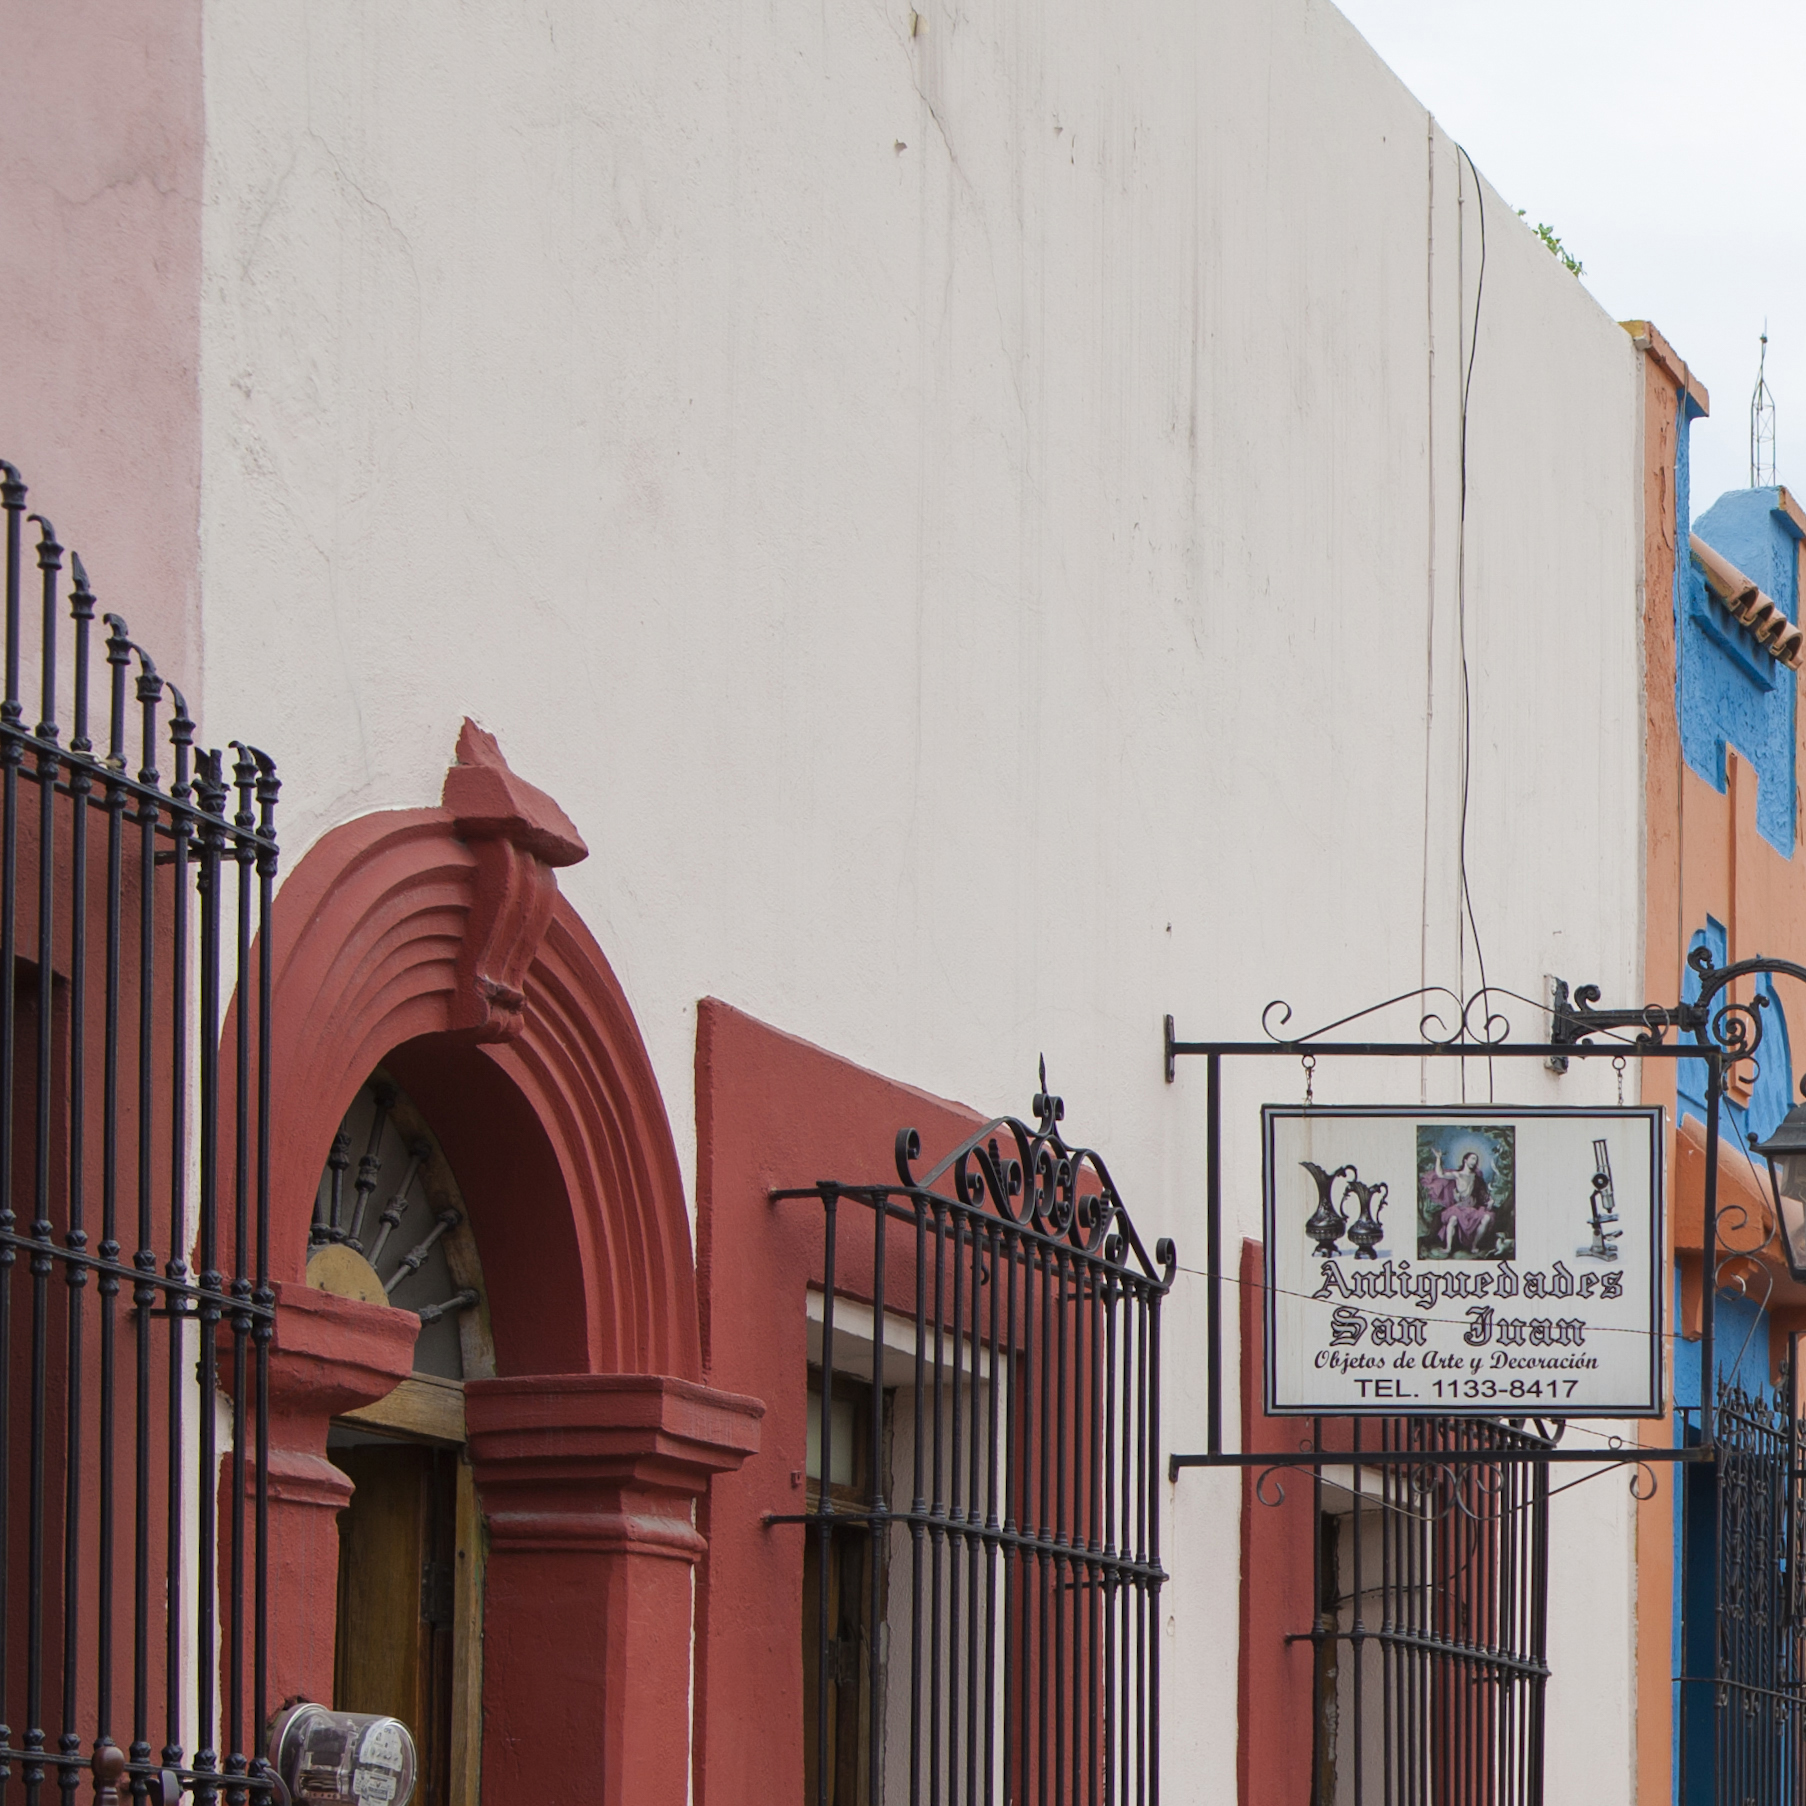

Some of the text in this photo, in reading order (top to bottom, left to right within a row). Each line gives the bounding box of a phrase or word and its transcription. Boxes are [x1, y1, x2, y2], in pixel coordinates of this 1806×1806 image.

[1312, 1259, 1625, 1310] Antiguedades
[1329, 1305, 1587, 1347] San Juan
[1314, 1349, 1600, 1375] Objetos de Arte y Decoración
[1353, 1378, 1580, 1399] TEL. 1133-8417
